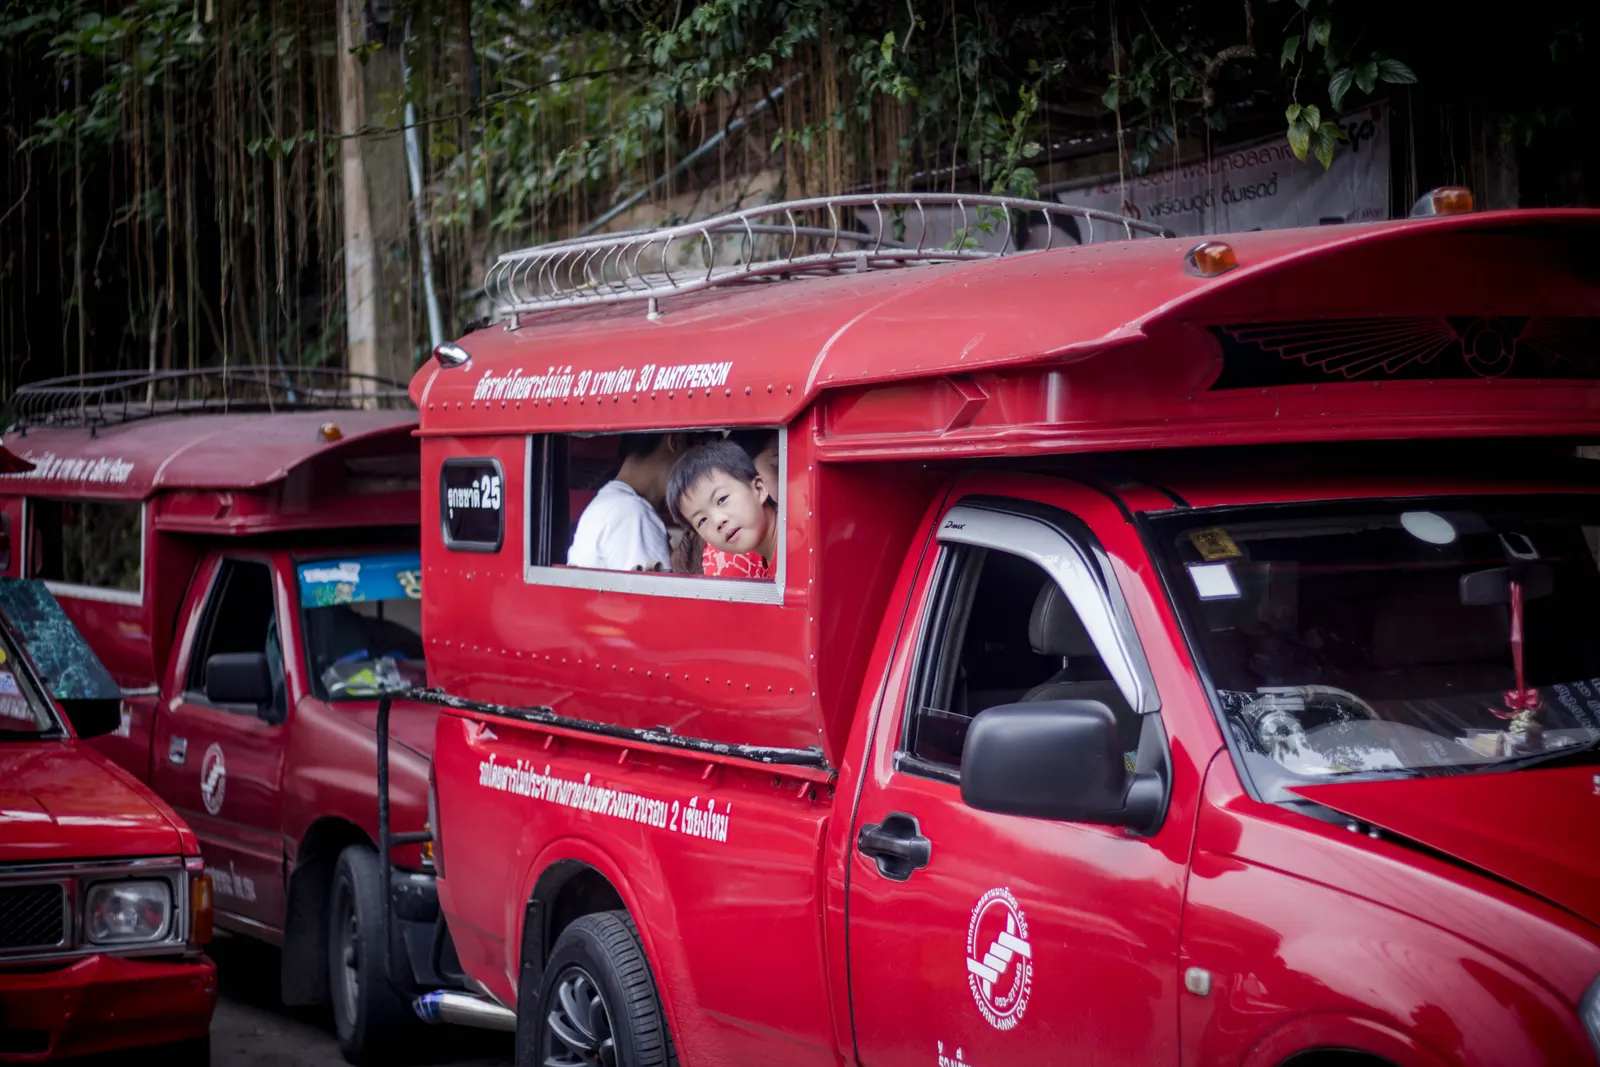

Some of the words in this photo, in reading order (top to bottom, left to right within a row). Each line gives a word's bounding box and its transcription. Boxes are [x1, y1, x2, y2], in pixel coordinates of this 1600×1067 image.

[573, 369, 593, 397] 30
[590, 366, 636, 396] บาท/คน
[636, 363, 656, 392] 30
[653, 361, 733, 391] BAHT/PERSON
[481, 474, 501, 510] 25
[669, 800, 680, 832] 2
[681, 796, 732, 843] เชียงใหม่
